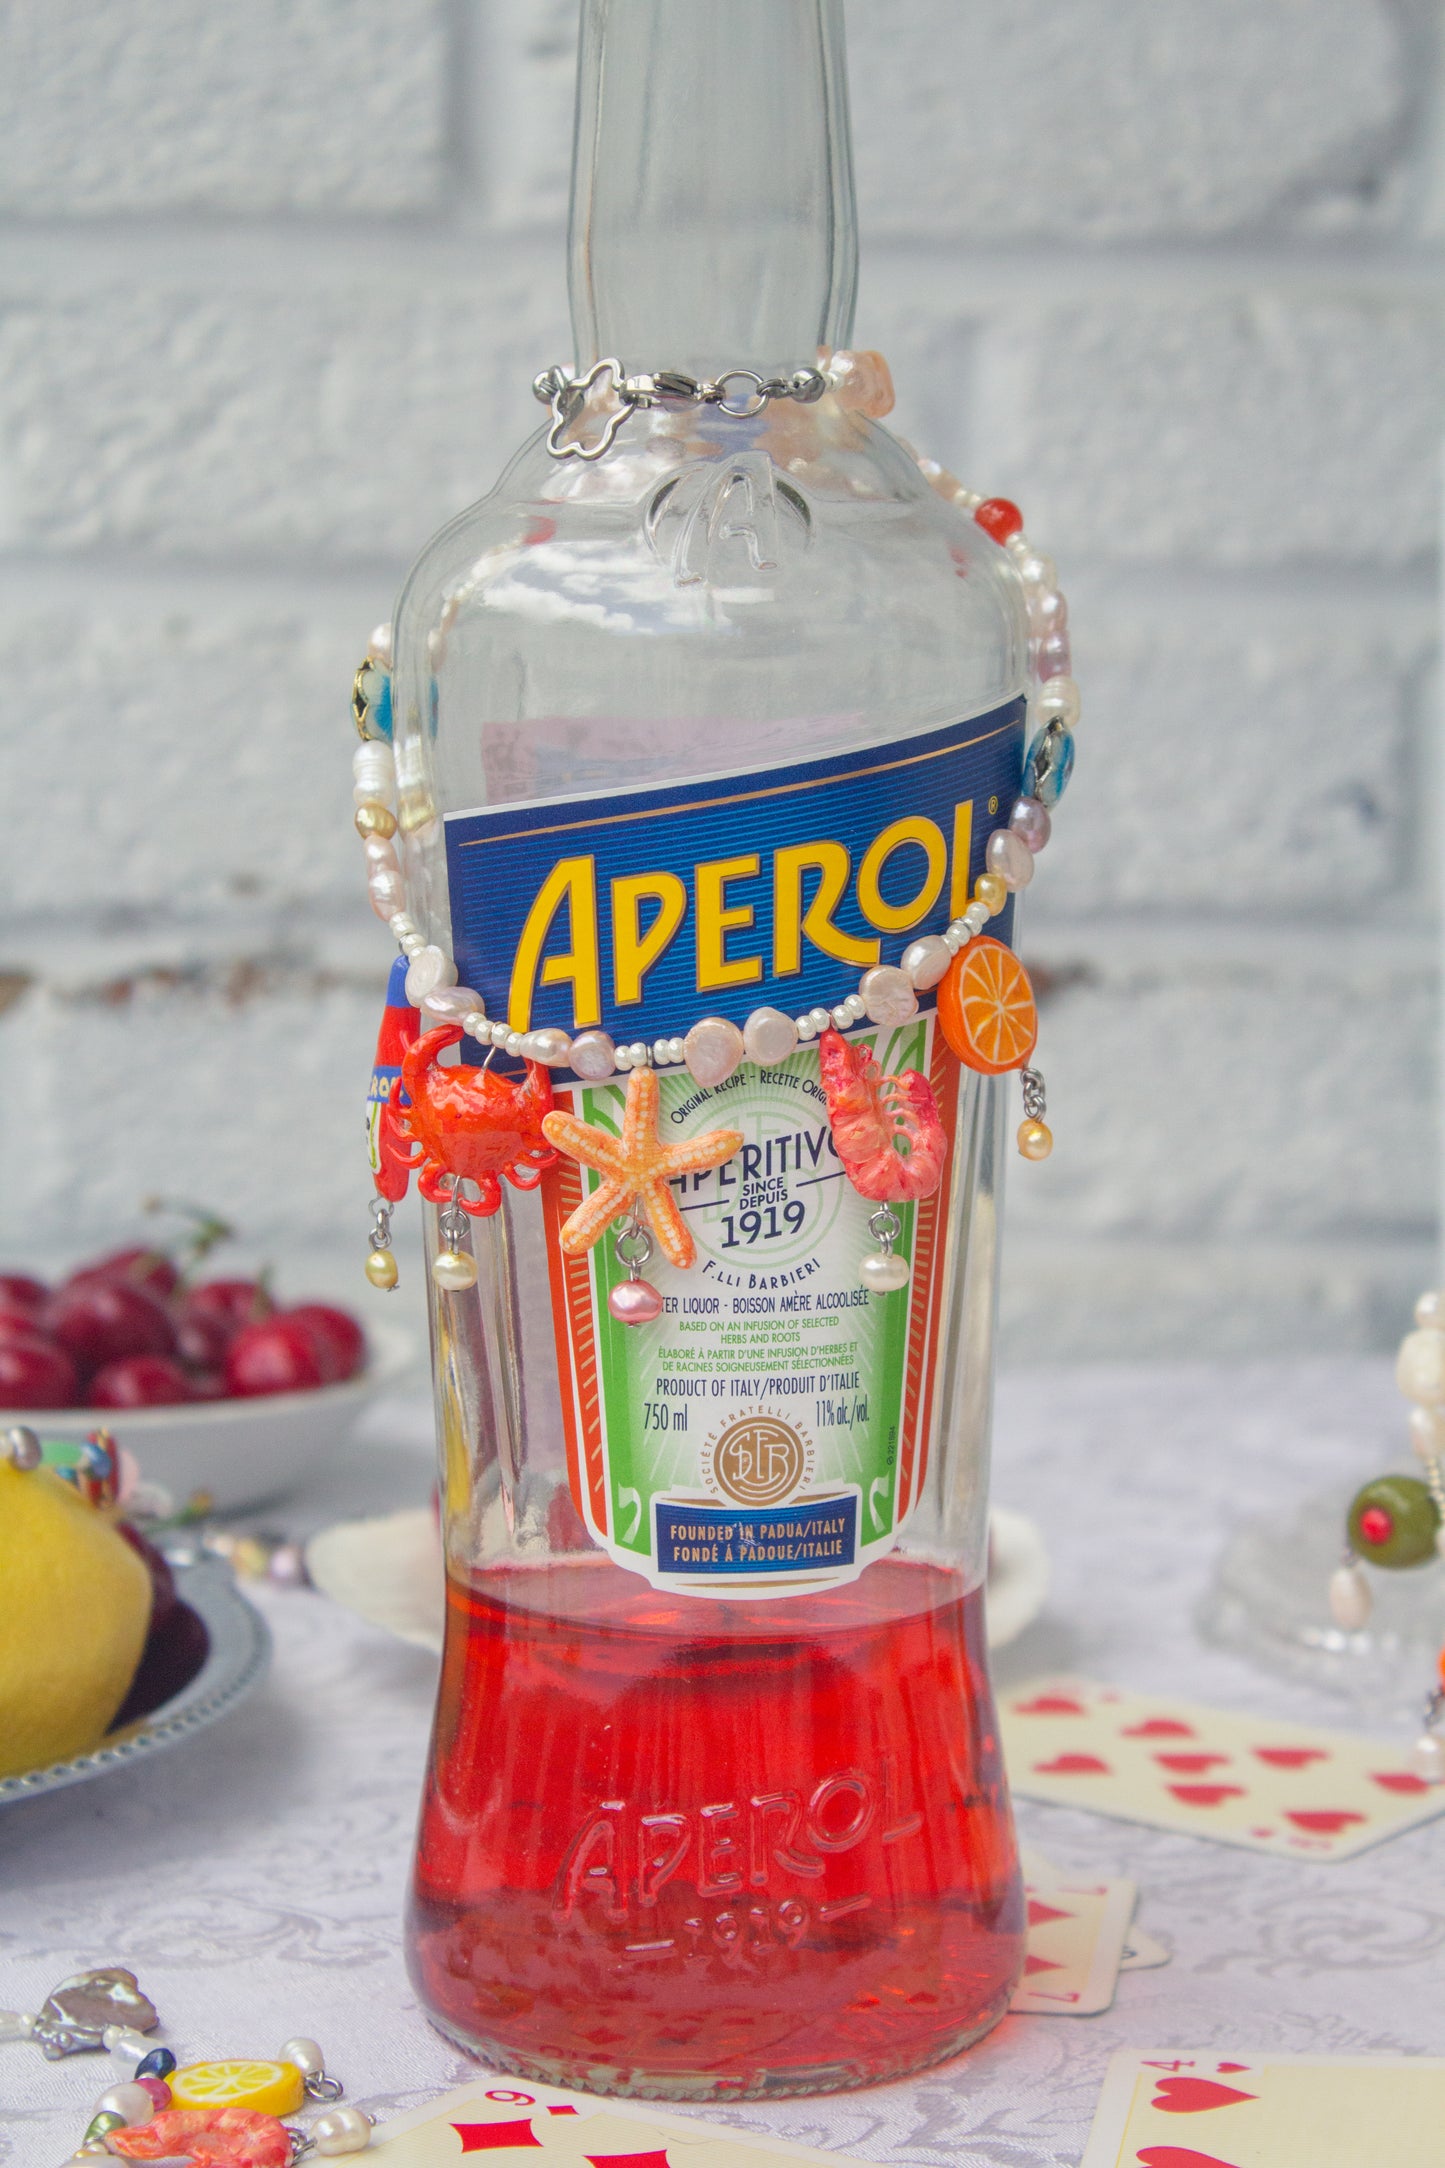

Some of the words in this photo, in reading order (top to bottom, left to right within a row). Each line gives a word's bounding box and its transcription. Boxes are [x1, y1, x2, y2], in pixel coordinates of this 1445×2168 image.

[506, 798, 976, 1034] APEROL
[801, 1079, 828, 1106] ORIGI
[742, 1176, 784, 1197] SINCE
[739, 1189, 789, 1211] DEPUIS
[720, 1200, 806, 1249] 1919
[749, 1257, 821, 1290] BARBIERI
[683, 1297, 720, 1315] LIQUOR
[732, 1297, 776, 1314] BOISSON
[779, 1290, 812, 1312] AMÈRE
[815, 1285, 870, 1310] ALCOOLISÉE
[679, 1321, 707, 1332] BASED
[709, 1321, 725, 1331] ON
[726, 1321, 741, 1331] AN
[743, 1319, 788, 1331] INFUSION
[788, 1319, 800, 1330] OF
[801, 1316, 839, 1329] SELECTED
[658, 1346, 695, 1360] ÉLABORÉ
[707, 1349, 735, 1360] PARTIR
[738, 1348, 765, 1359] D'UNE
[767, 1346, 809, 1359] INFUSION
[810, 1343, 848, 1356] D'HERBES
[849, 1342, 858, 1353] ET
[720, 1334, 747, 1345] HERBS
[749, 1333, 770, 1344] AND
[771, 1332, 800, 1343] ROOTS
[662, 1361, 674, 1371] DE
[676, 1361, 713, 1372] RACINES
[716, 1360, 790, 1372] SOIGNEUSEMENT
[791, 1355, 854, 1370] SÉLECTIONNÉES
[656, 1378, 707, 1396] PRODUCT
[711, 1379, 726, 1397] OF
[730, 1375, 815, 1400] ITALY/PRODUIT
[819, 1371, 860, 1392] D'ITALIE
[643, 1403, 669, 1430] 750
[673, 1403, 688, 1431] ml
[815, 1400, 835, 1427] 11%
[836, 1394, 870, 1431] alc./vol.
[719, 1405, 790, 1429] FRATELLI
[794, 1421, 815, 1491] BARBIERI
[670, 1525, 734, 1541] FOUNDED
[739, 1524, 754, 1540] IN
[760, 1518, 846, 1539] PADUA/ITALY
[673, 1544, 719, 1562] FONDÉ
[739, 1540, 843, 1562] PADOUE/ITALIE
[1140, 2059, 1197, 2073] 4
